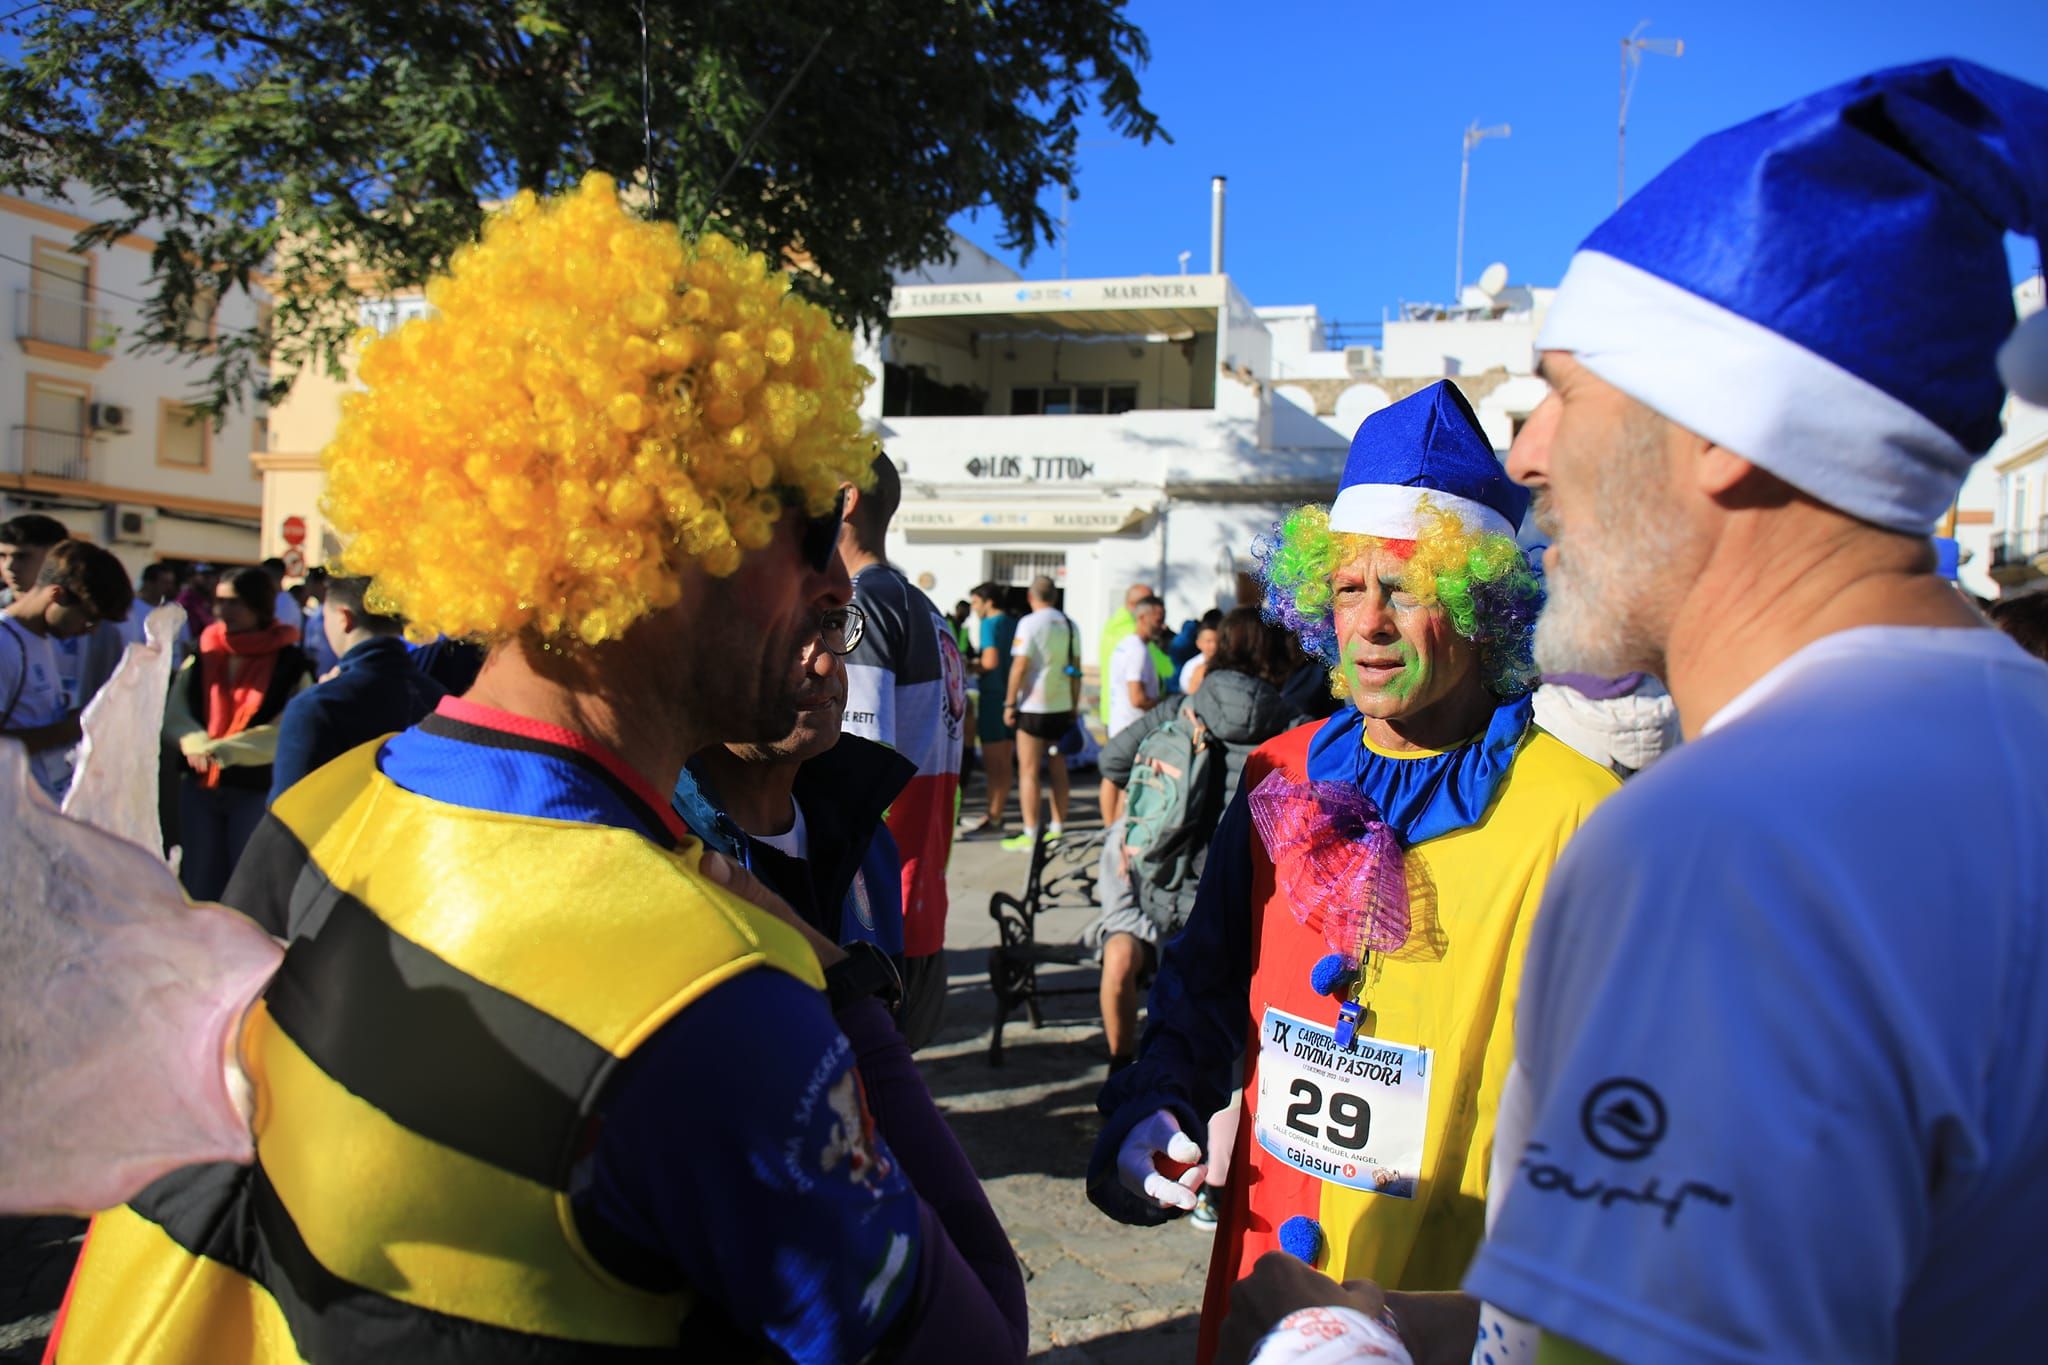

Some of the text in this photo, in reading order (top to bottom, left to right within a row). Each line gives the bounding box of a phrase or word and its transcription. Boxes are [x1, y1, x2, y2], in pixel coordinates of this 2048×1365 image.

[1102, 284, 1198, 300] MARINERA
[990, 456, 1021, 478] LOS
[1053, 514, 1120, 525] MARINER
[853, 711, 875, 724] RETT
[1298, 1027, 1337, 1051] CARRERA
[1294, 1042, 1402, 1086] DIVINA PASTORA
[1286, 1078, 1371, 1150] 29
[1287, 1147, 1341, 1176] cajasur
[1323, 1145, 1349, 1159] MIGUEL
